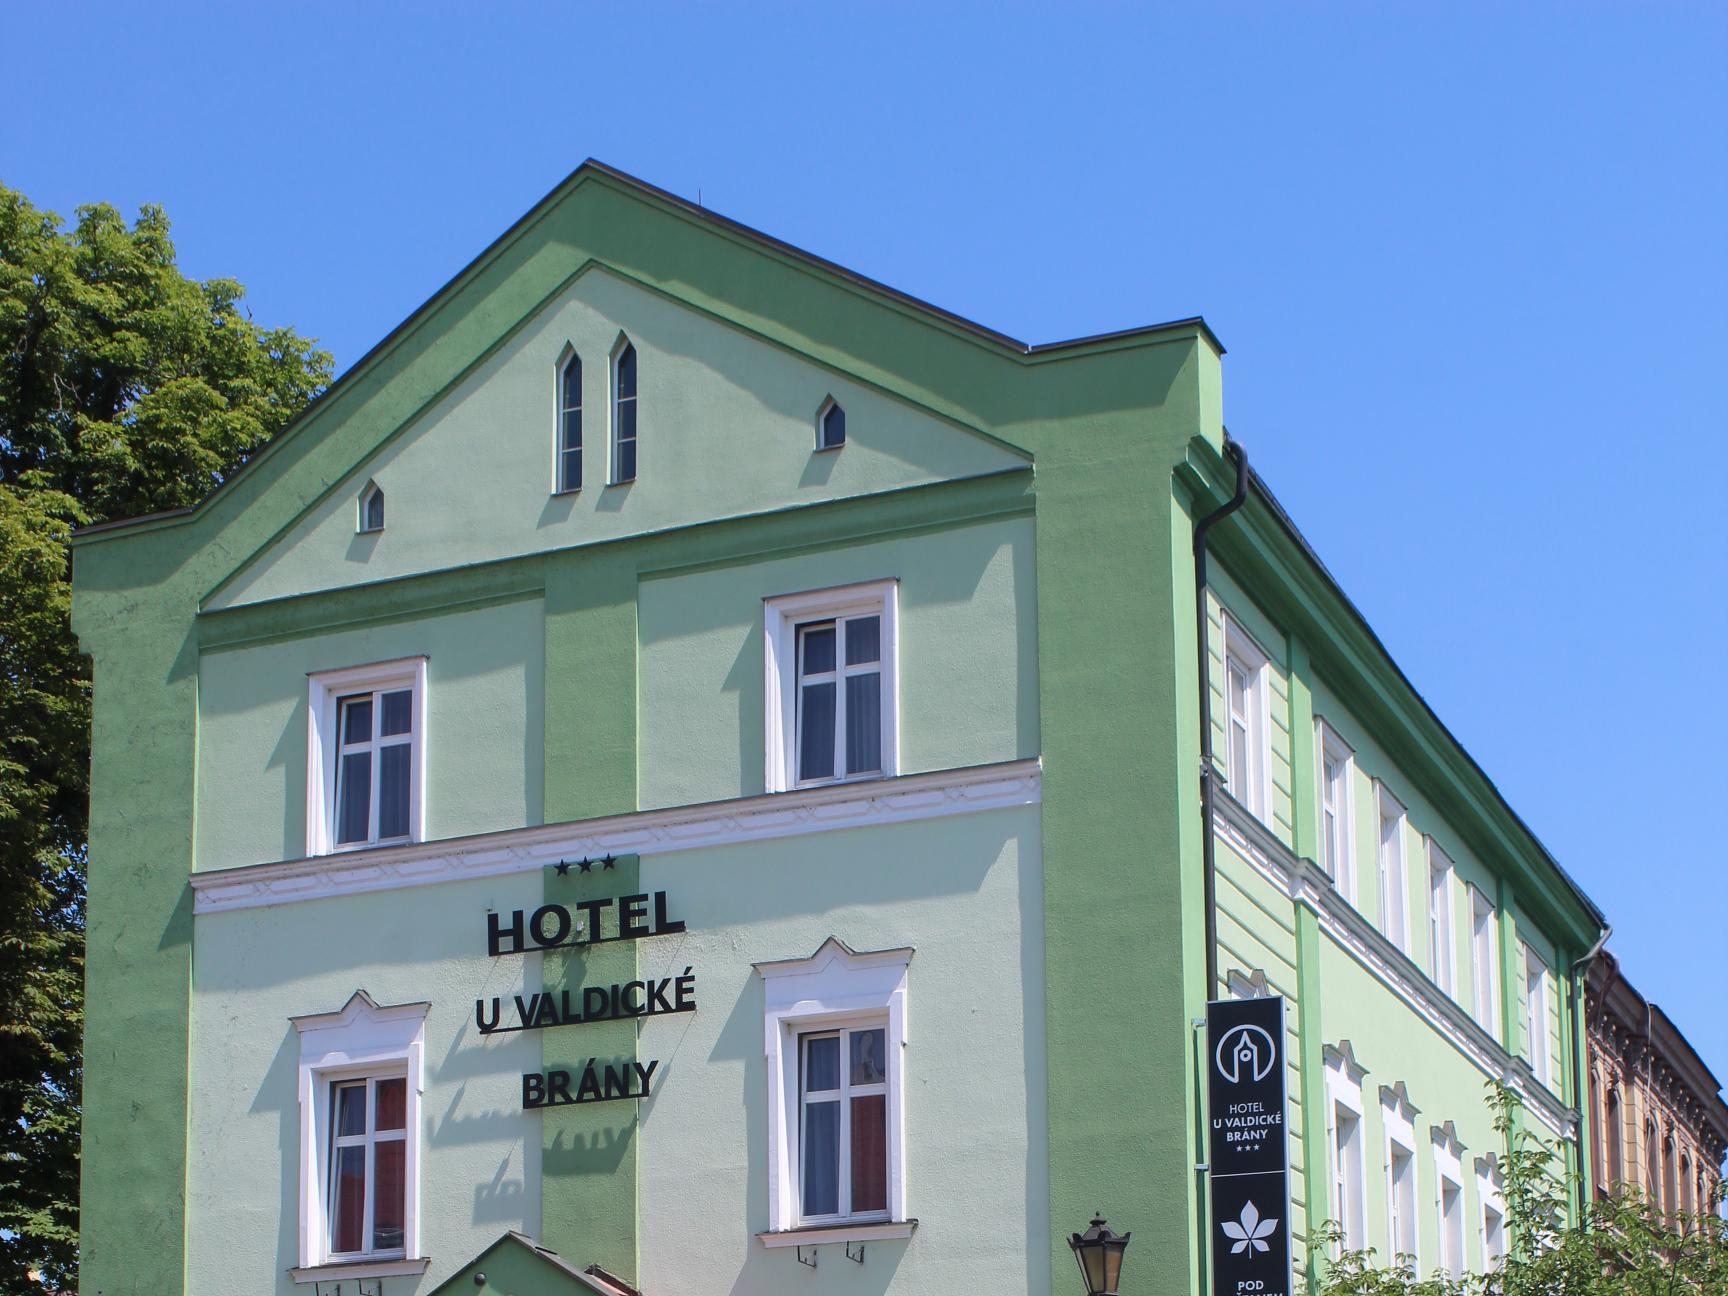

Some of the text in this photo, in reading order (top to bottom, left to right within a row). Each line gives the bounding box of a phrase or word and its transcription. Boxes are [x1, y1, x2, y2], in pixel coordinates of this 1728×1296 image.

[488, 891, 686, 956] HOTEL
[476, 966, 697, 1031] U VALDICKÉ
[523, 1057, 659, 1109] BRÁNY
[1229, 1102, 1265, 1114] HOTEL
[1213, 1110, 1282, 1129] U VALDICKÉ
[1226, 1128, 1269, 1142] BRÁNY
[1237, 1280, 1264, 1292] POD
